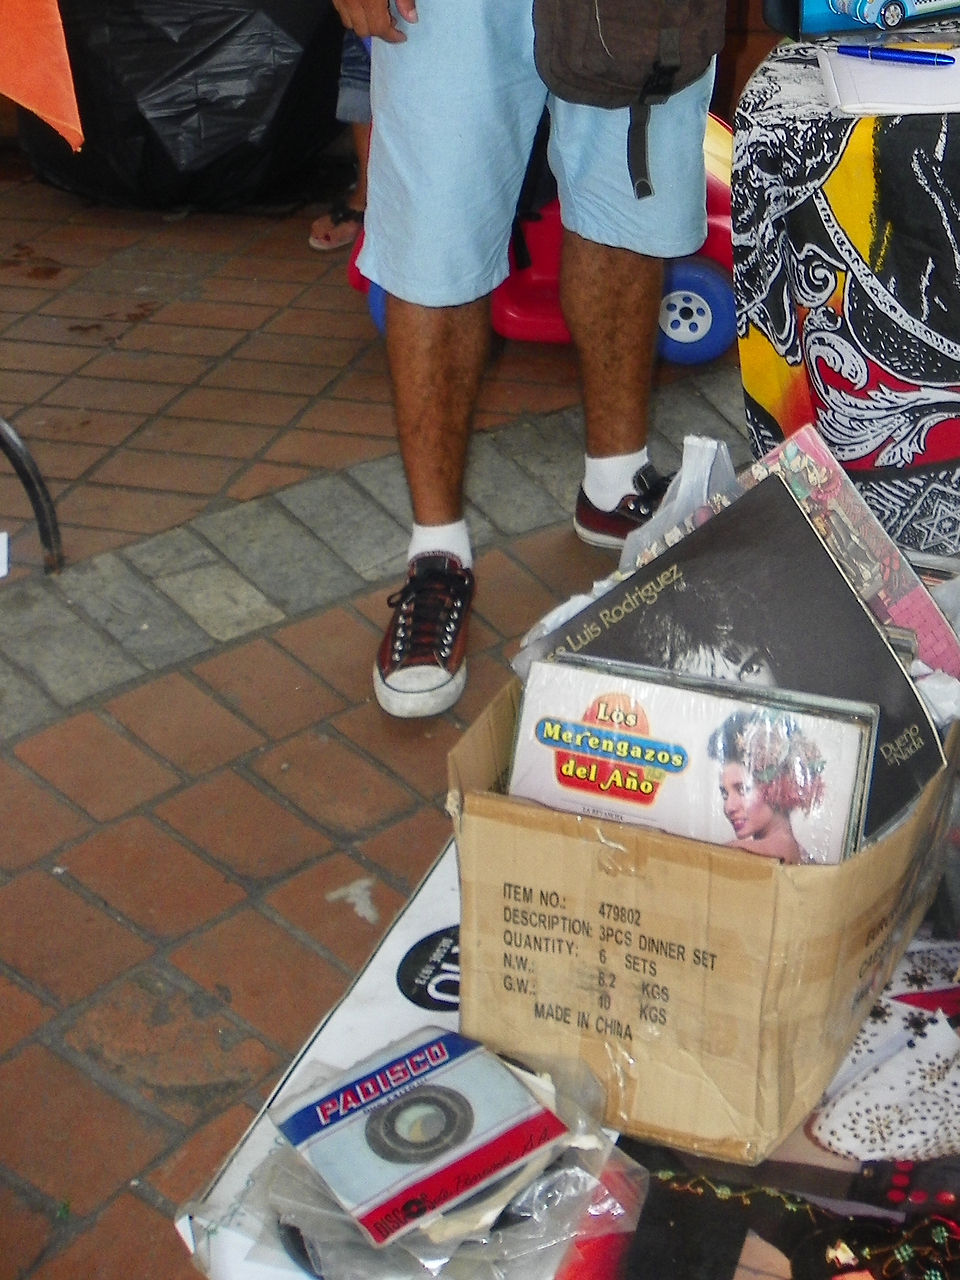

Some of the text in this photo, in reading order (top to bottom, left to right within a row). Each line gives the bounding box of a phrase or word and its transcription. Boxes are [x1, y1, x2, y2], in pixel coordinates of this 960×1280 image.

[566, 621, 602, 652] Luis
[599, 563, 684, 630] Rodriguez
[596, 702, 638, 728] Los
[543, 721, 684, 767] Merengazos
[561, 759, 654, 795] del Año
[503, 882, 533, 903] ITEM
[599, 901, 641, 926] 479802
[503, 907, 717, 971] DESCRIPTION: 3PCS DINNER SET
[599, 949, 607, 964] 6
[625, 954, 657, 977] SETS
[641, 981, 669, 1002] KGS
[534, 1002, 633, 1041] MADE IN CHINA
[639, 1003, 667, 1025] KGS
[315, 1041, 449, 1125] PADISCO
